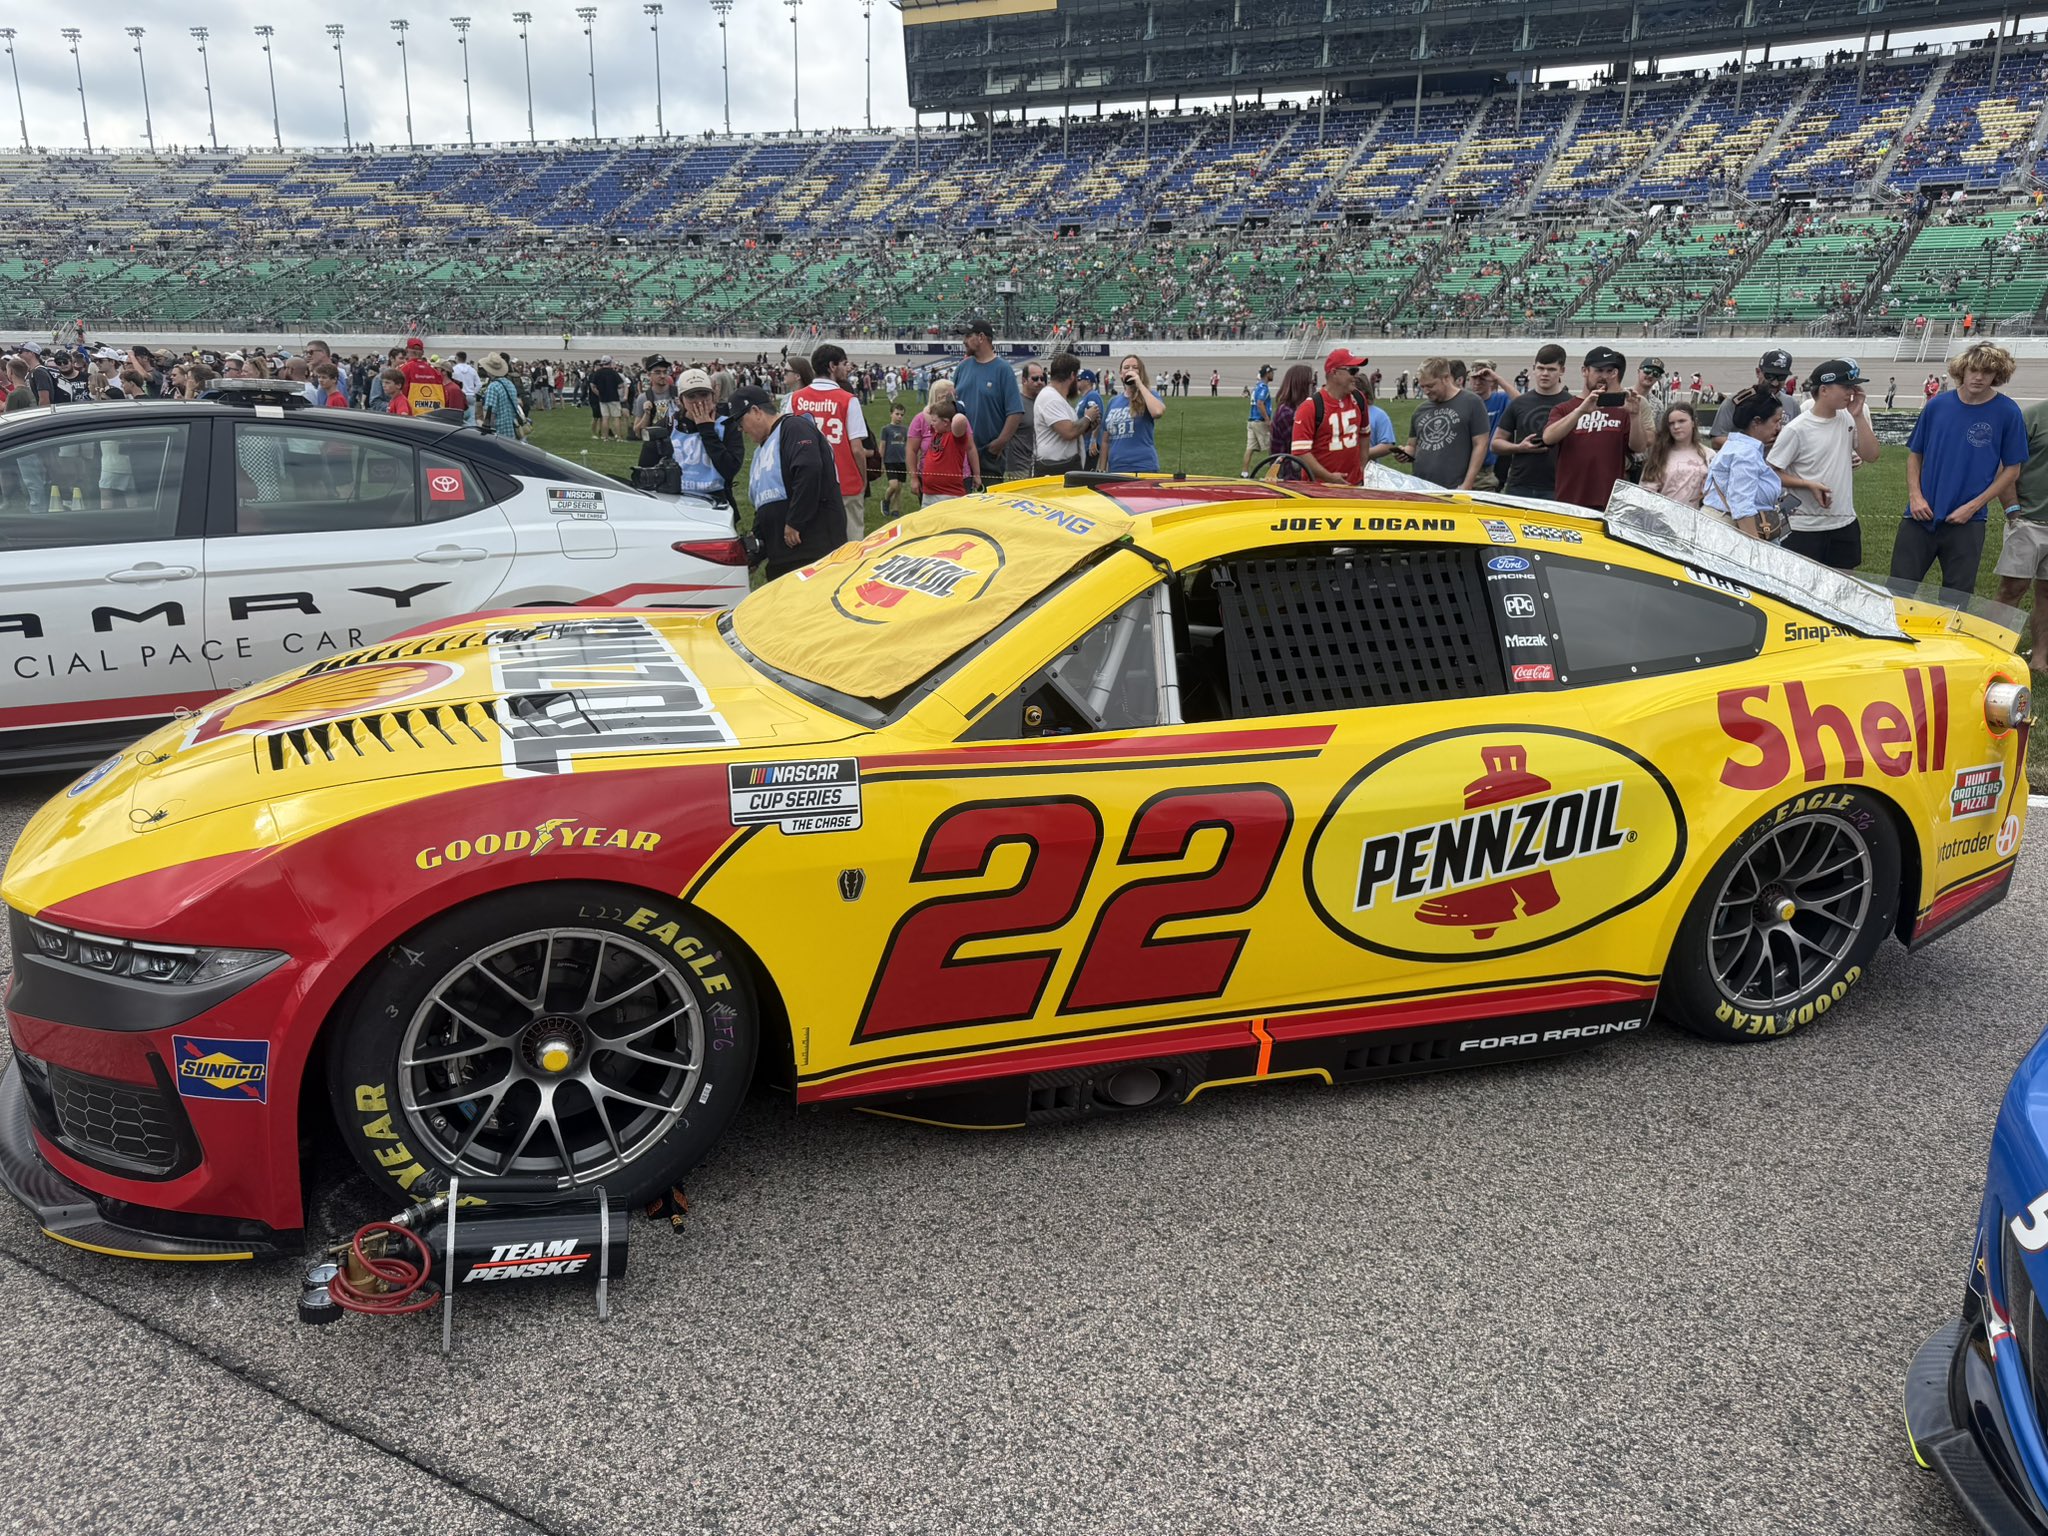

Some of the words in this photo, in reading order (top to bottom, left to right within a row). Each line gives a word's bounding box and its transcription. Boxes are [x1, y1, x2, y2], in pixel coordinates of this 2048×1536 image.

[797, 396, 838, 416] Security
[1590, 410, 1610, 421] Dr
[1328, 409, 1358, 452] 15
[1575, 413, 1622, 433] Pepper
[557, 501, 573, 509] CUP
[573, 502, 598, 510] SERIES
[565, 490, 596, 500] NASCAR
[1270, 517, 1344, 532] JOEY
[1353, 518, 1456, 532] LOGANO
[1496, 557, 1523, 570] Ford
[1487, 572, 1536, 582] RACING
[1506, 595, 1534, 616] PPG
[1504, 633, 1548, 648] Mazak
[13, 648, 119, 680] CIAL
[140, 636, 253, 667] PACE
[282, 627, 365, 654] CAR
[1717, 665, 1949, 791] Shell
[771, 763, 840, 784] NASCAR
[1964, 770, 1993, 788] HUNT
[750, 792, 784, 810] CUP
[785, 788, 843, 808] SERIES
[1953, 781, 2000, 801] BROTHERS
[1773, 792, 1856, 825] EAGLE
[1960, 795, 1988, 812] PIZZA
[792, 818, 814, 831] THE
[815, 816, 852, 829] CHASE
[1353, 780, 1628, 912] PENNZOIL
[849, 782, 1295, 1047] 22
[622, 906, 733, 995] EAGLE
[1459, 1032, 1539, 1052] FORD
[1543, 1018, 1642, 1042] RACING
[182, 1060, 264, 1081] SUNOCO
[489, 1238, 580, 1263] TEAM
[462, 1258, 588, 1284] PENSKE
